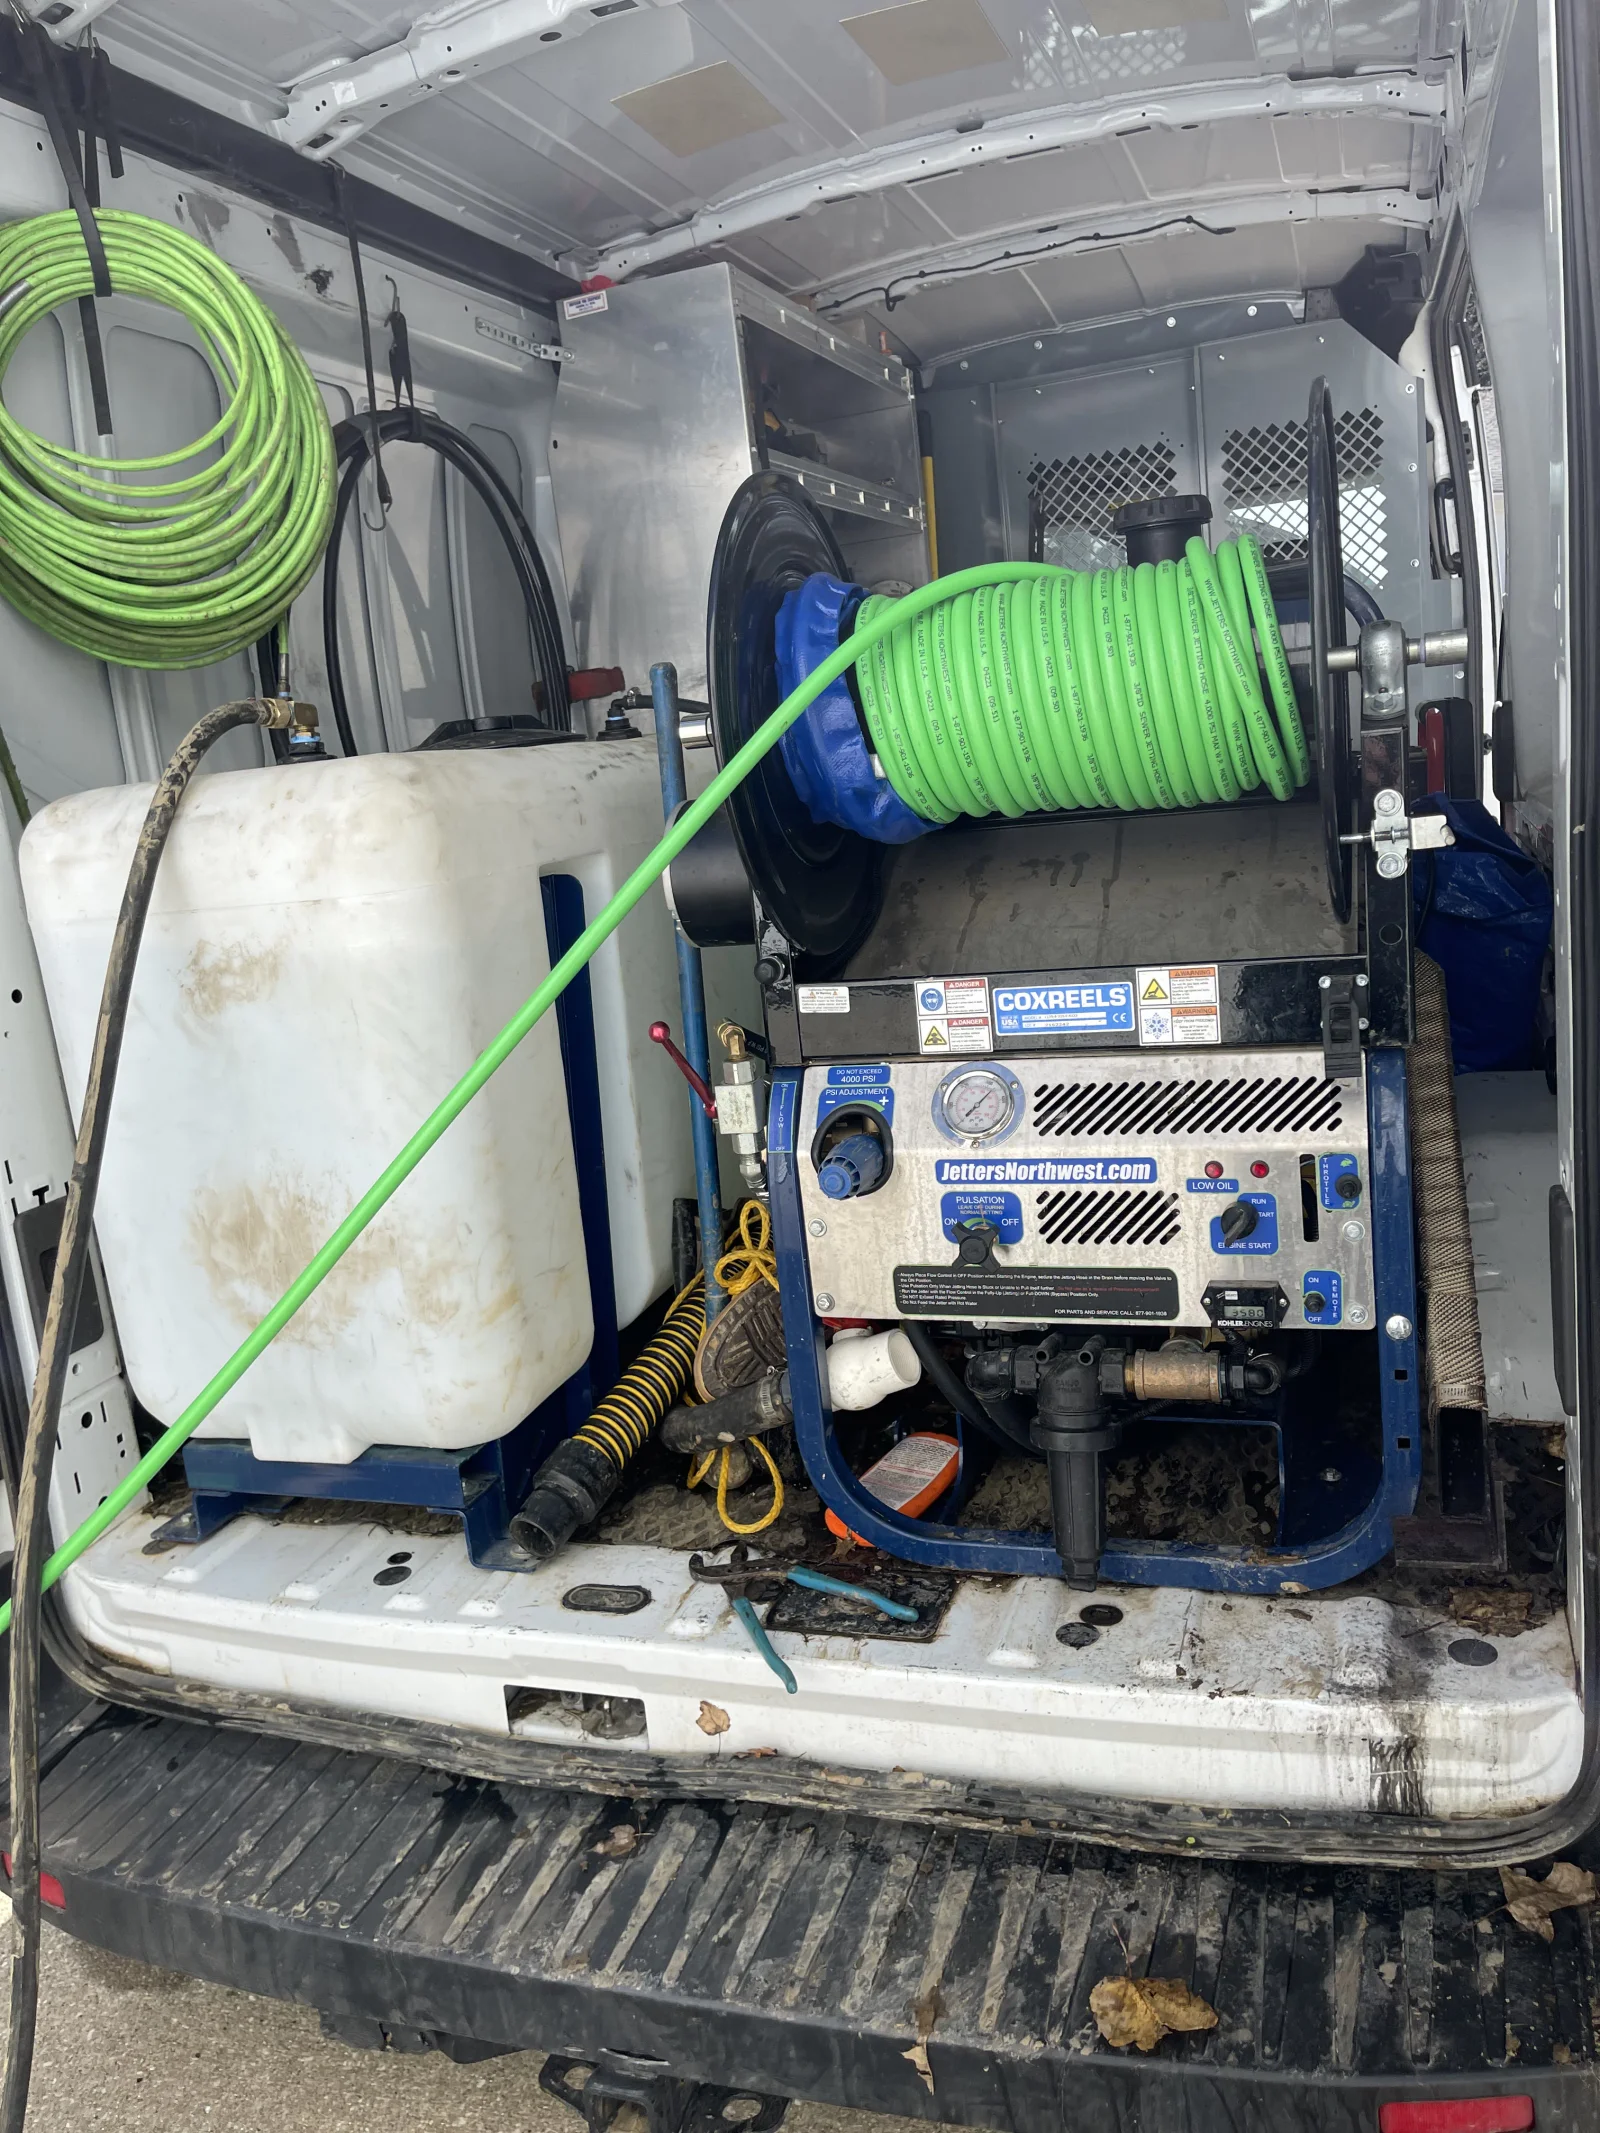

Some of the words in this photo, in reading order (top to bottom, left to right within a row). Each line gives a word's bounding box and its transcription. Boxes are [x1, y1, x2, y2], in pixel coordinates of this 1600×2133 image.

[1190, 609, 1199, 635] SEWER
[1193, 636, 1204, 670] JETTING
[1263, 598, 1272, 619] HOSE
[1278, 662, 1287, 680] MAX
[1287, 702, 1298, 723] MADE
[983, 666, 993, 688] 04221
[1045, 656, 1054, 679] 04221
[1124, 613, 1137, 667] 1-877-901-1936
[1140, 711, 1150, 739] SEWER
[1146, 740, 1159, 768] JETTING
[1200, 671, 1209, 694] HOSE
[925, 690, 934, 712] 04221
[1071, 685, 1088, 742] 1-877-901-1936
[1204, 699, 1214, 721] 4,000
[952, 715, 974, 768] 1-877-901-1936
[1012, 709, 1032, 763] 1-877-901-1936
[1212, 735, 1221, 751] MAX
[1253, 710, 1277, 760] 1-877-901-1936
[892, 727, 914, 779] 1-877-901-1936
[998, 988, 1126, 1011] COXREELS
[942, 1162, 1151, 1181] JettersNorthwest.com
